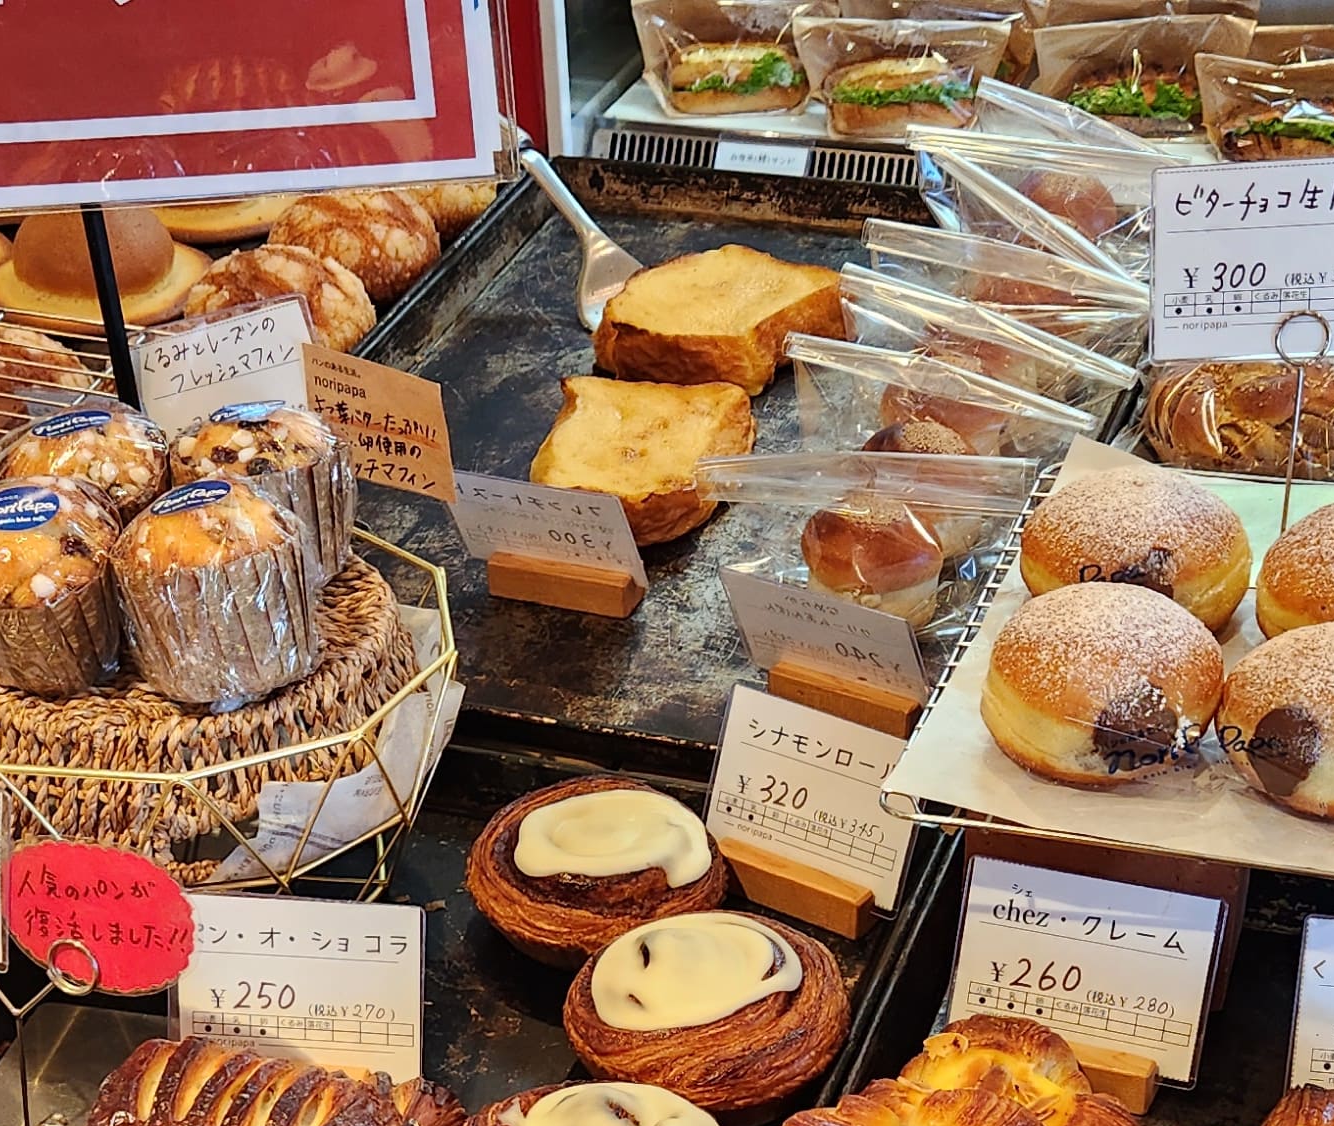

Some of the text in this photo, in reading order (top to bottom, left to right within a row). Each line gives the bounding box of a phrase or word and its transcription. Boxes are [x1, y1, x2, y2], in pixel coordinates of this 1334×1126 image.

[1183, 262, 1266, 292] ¥300
[1182, 321, 1228, 330] noripapa
[143, 317, 275, 373] くるみとレーズンの
[170, 345, 295, 393] フレッシュマフィン
[314, 373, 367, 399] noripapa
[351, 456, 436, 490] ッチマフィン
[738, 775, 808, 810] ¥320
[737, 823, 773, 841] noripapa
[17, 863, 155, 901] 人気のパンが
[1011, 883, 1034, 898] シェ
[25, 907, 188, 952] 復活しました!!
[990, 958, 1082, 992] ¥260
[210, 981, 296, 1009] ¥250
